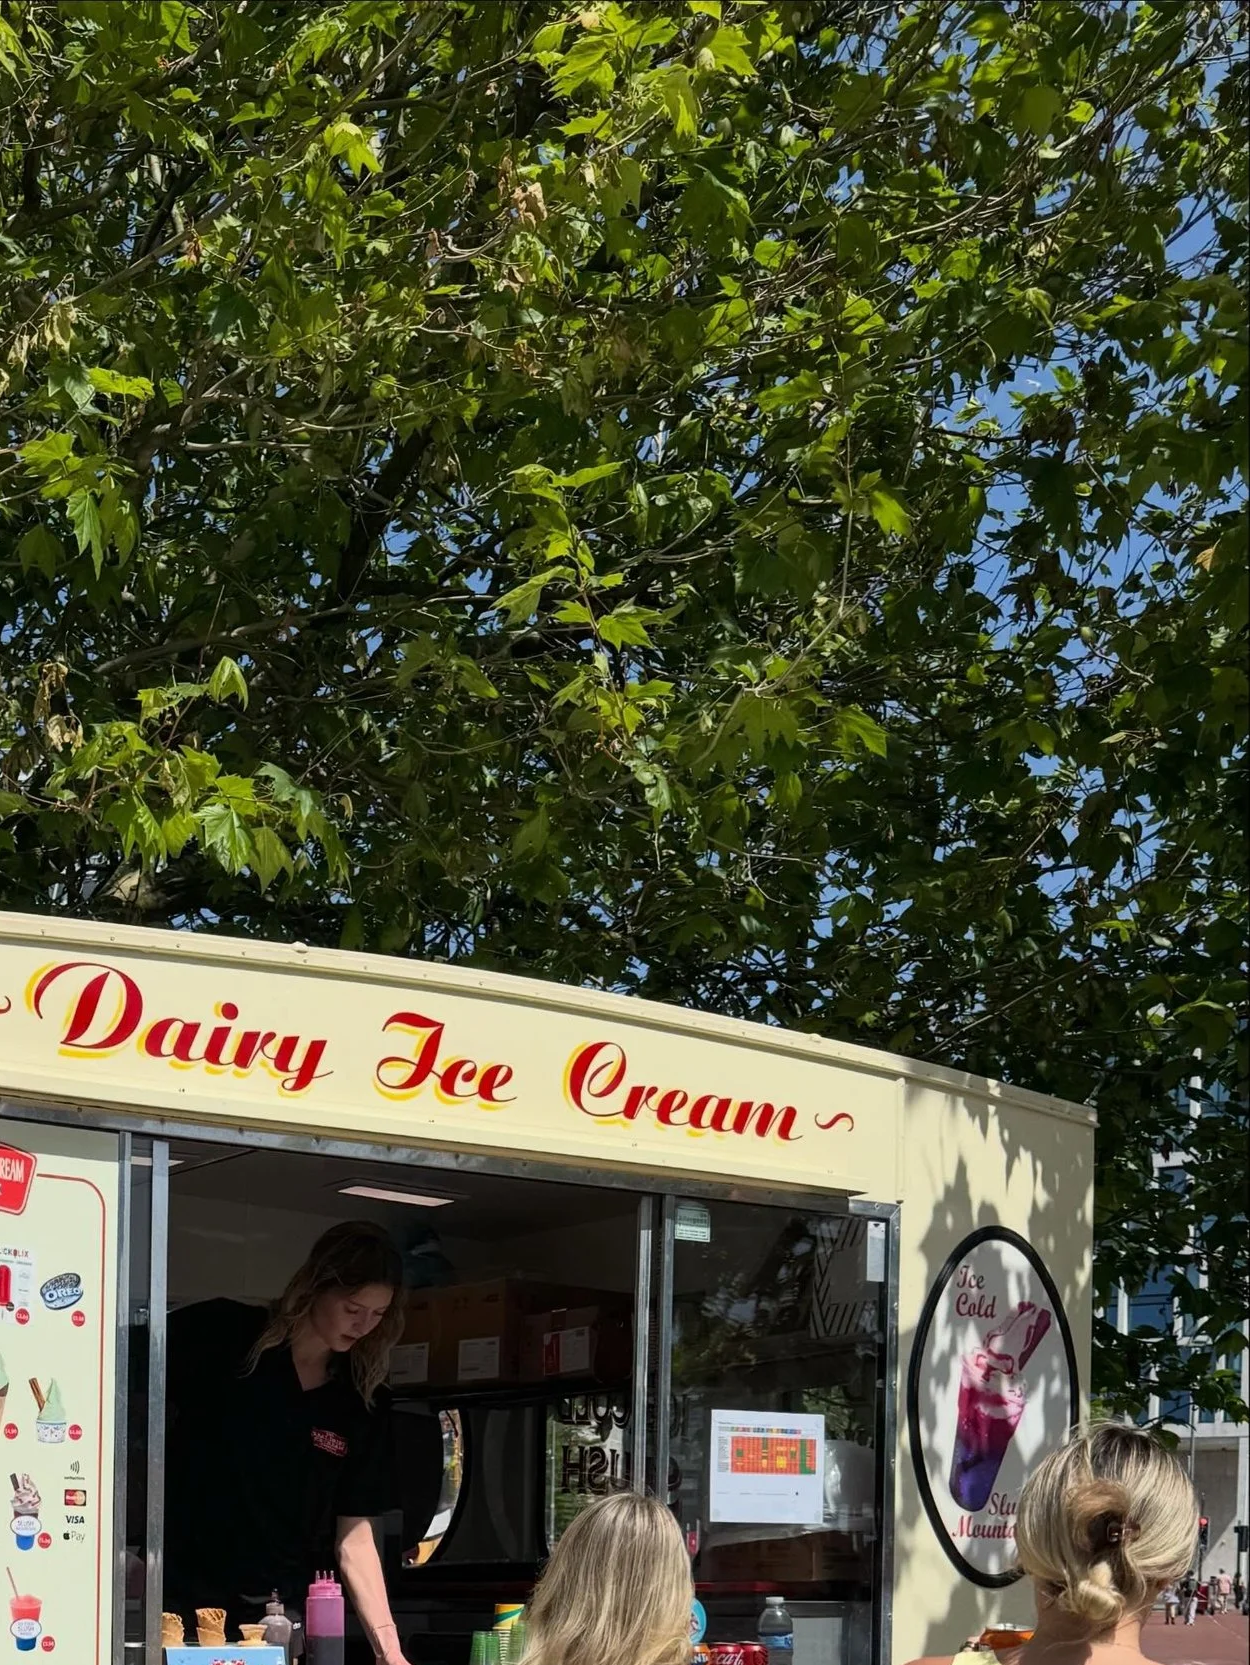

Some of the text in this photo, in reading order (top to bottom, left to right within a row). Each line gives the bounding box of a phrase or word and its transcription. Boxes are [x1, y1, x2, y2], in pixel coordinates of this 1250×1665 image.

[25, 961, 803, 1144] Dairy Ice Cream
[956, 1265, 986, 1290] Ice
[44, 1288, 82, 1302] OREO
[955, 1293, 997, 1320] Cold
[988, 1492, 1017, 1517] Slu
[65, 1515, 85, 1524] VISA
[71, 1531, 86, 1543] Pay
